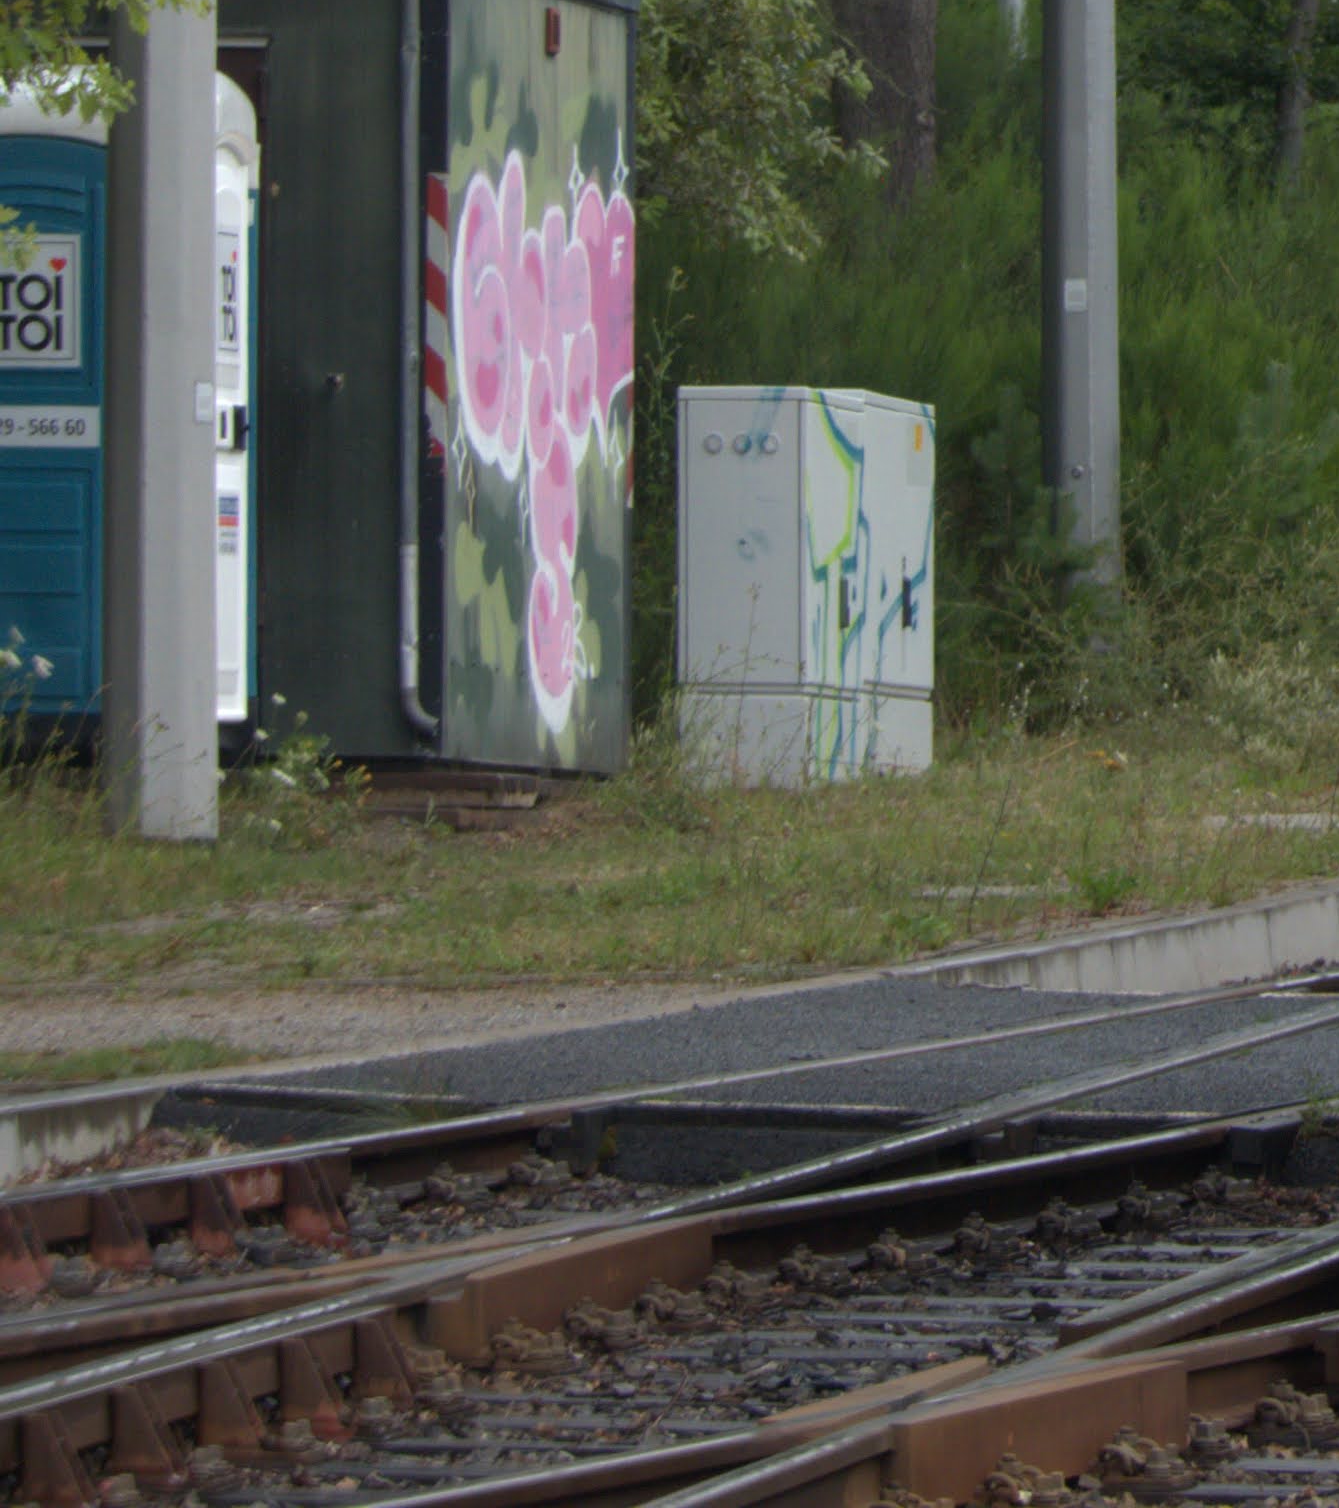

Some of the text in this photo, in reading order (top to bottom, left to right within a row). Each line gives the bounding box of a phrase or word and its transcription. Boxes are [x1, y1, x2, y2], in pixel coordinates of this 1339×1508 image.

[0, 274, 63, 311] TOI
[0, 314, 63, 351] TOI
[65, 418, 86, 436] 60
